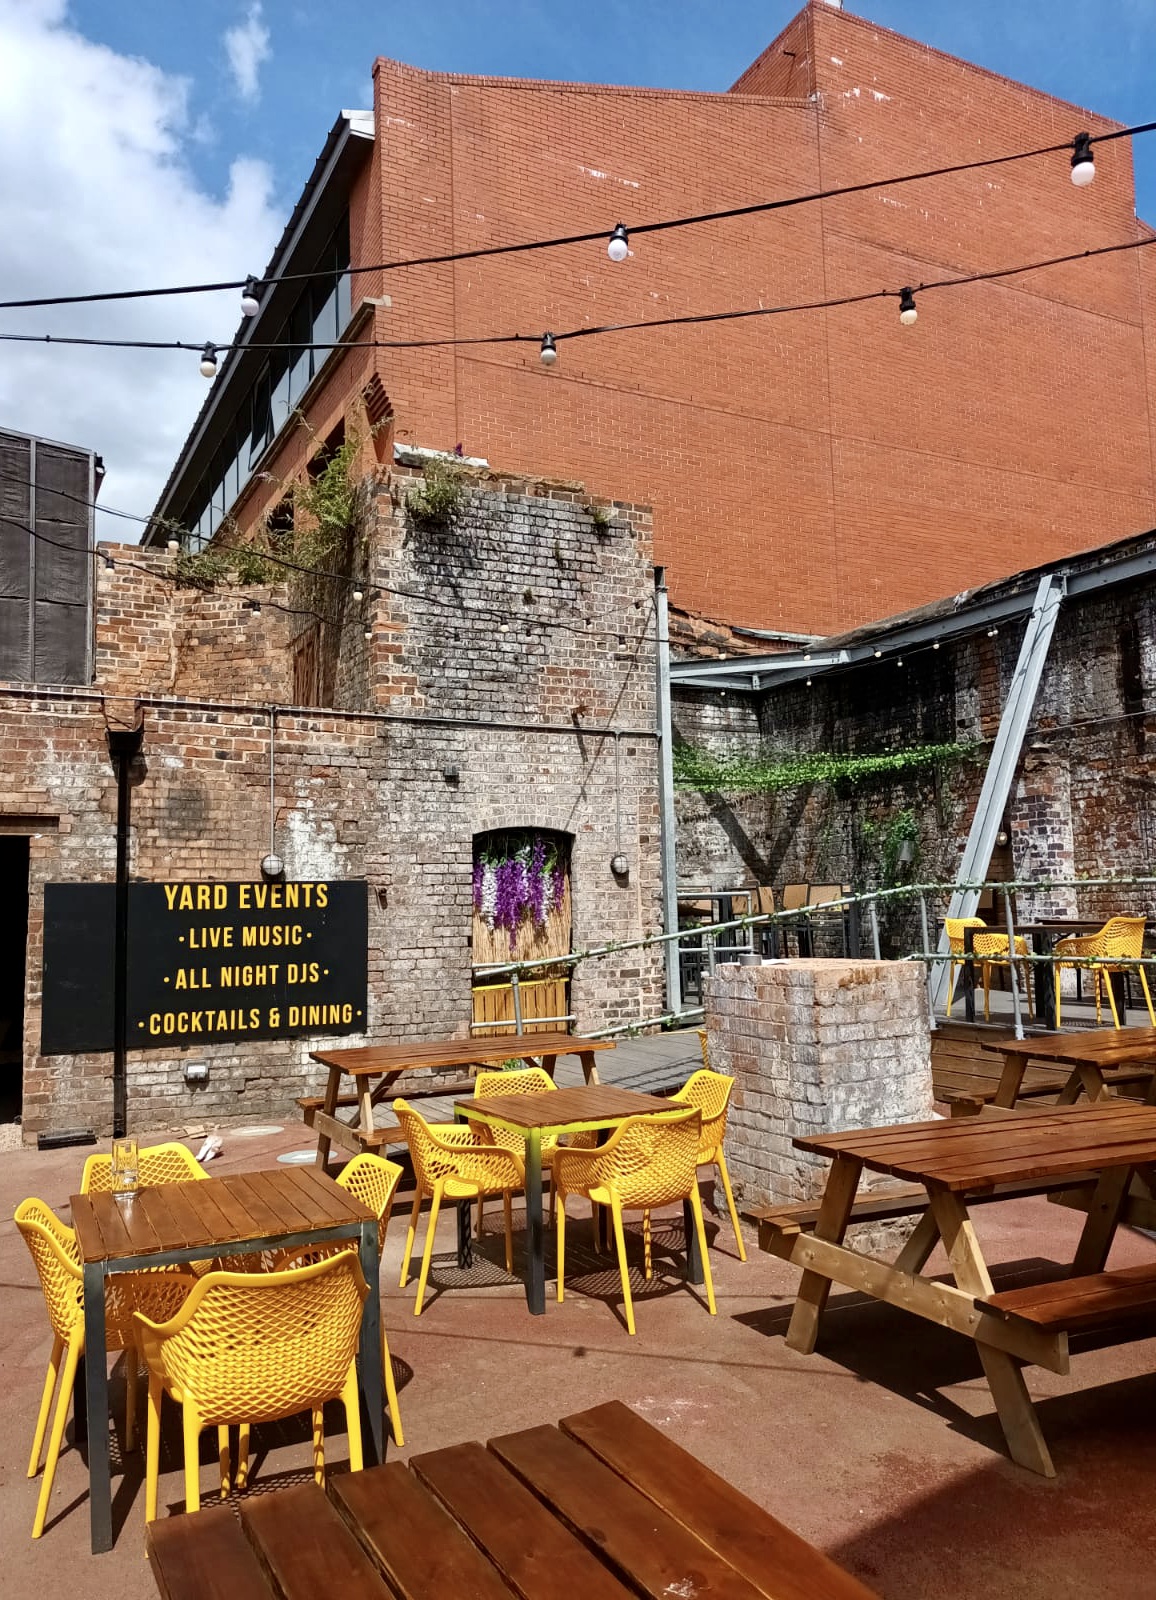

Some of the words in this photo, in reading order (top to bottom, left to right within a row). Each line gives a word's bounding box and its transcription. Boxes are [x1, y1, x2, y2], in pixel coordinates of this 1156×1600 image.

[164, 884, 227, 911] YARD
[239, 883, 328, 909] EVENTS
[189, 926, 234, 949] LIVE
[242, 924, 303, 947] MUSIC
[175, 968, 212, 990] ALL
[220, 964, 280, 988] NIGHT
[287, 962, 320, 984] DJS
[149, 1007, 261, 1035] COCKTAILS
[268, 1007, 281, 1028] &
[288, 1003, 353, 1027] DINING
